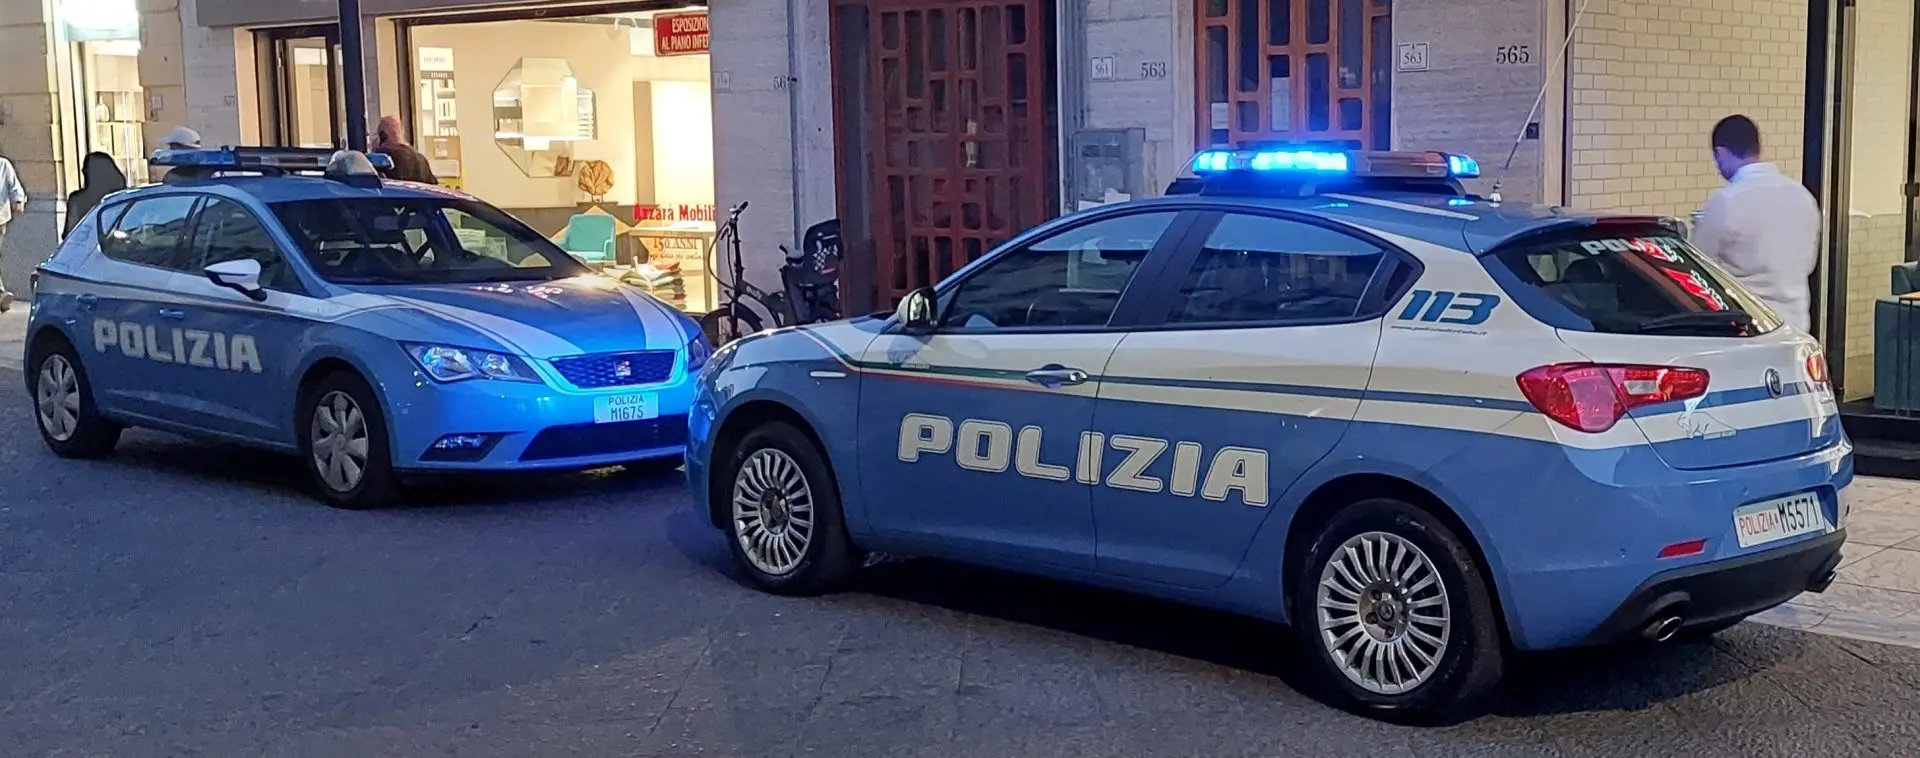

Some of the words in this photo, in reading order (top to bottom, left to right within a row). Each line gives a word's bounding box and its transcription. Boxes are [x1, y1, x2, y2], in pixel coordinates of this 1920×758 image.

[661, 36, 671, 51] AL
[671, 35, 691, 50] PIANO
[1403, 52, 1422, 65] 563
[1496, 45, 1530, 64] 565
[1095, 63, 1109, 76] 561
[1141, 62, 1167, 79] 563
[679, 204, 716, 221] Mobili
[653, 238, 670, 251] 150
[671, 237, 698, 250] ANNI
[1398, 289, 1501, 325] 113
[93, 318, 263, 374] POLIZIA
[608, 394, 644, 405] POLIZIA
[898, 411, 1271, 507] POLIZIA
[1738, 512, 1776, 537] POLIZIA
[1777, 495, 1819, 534] M5571
